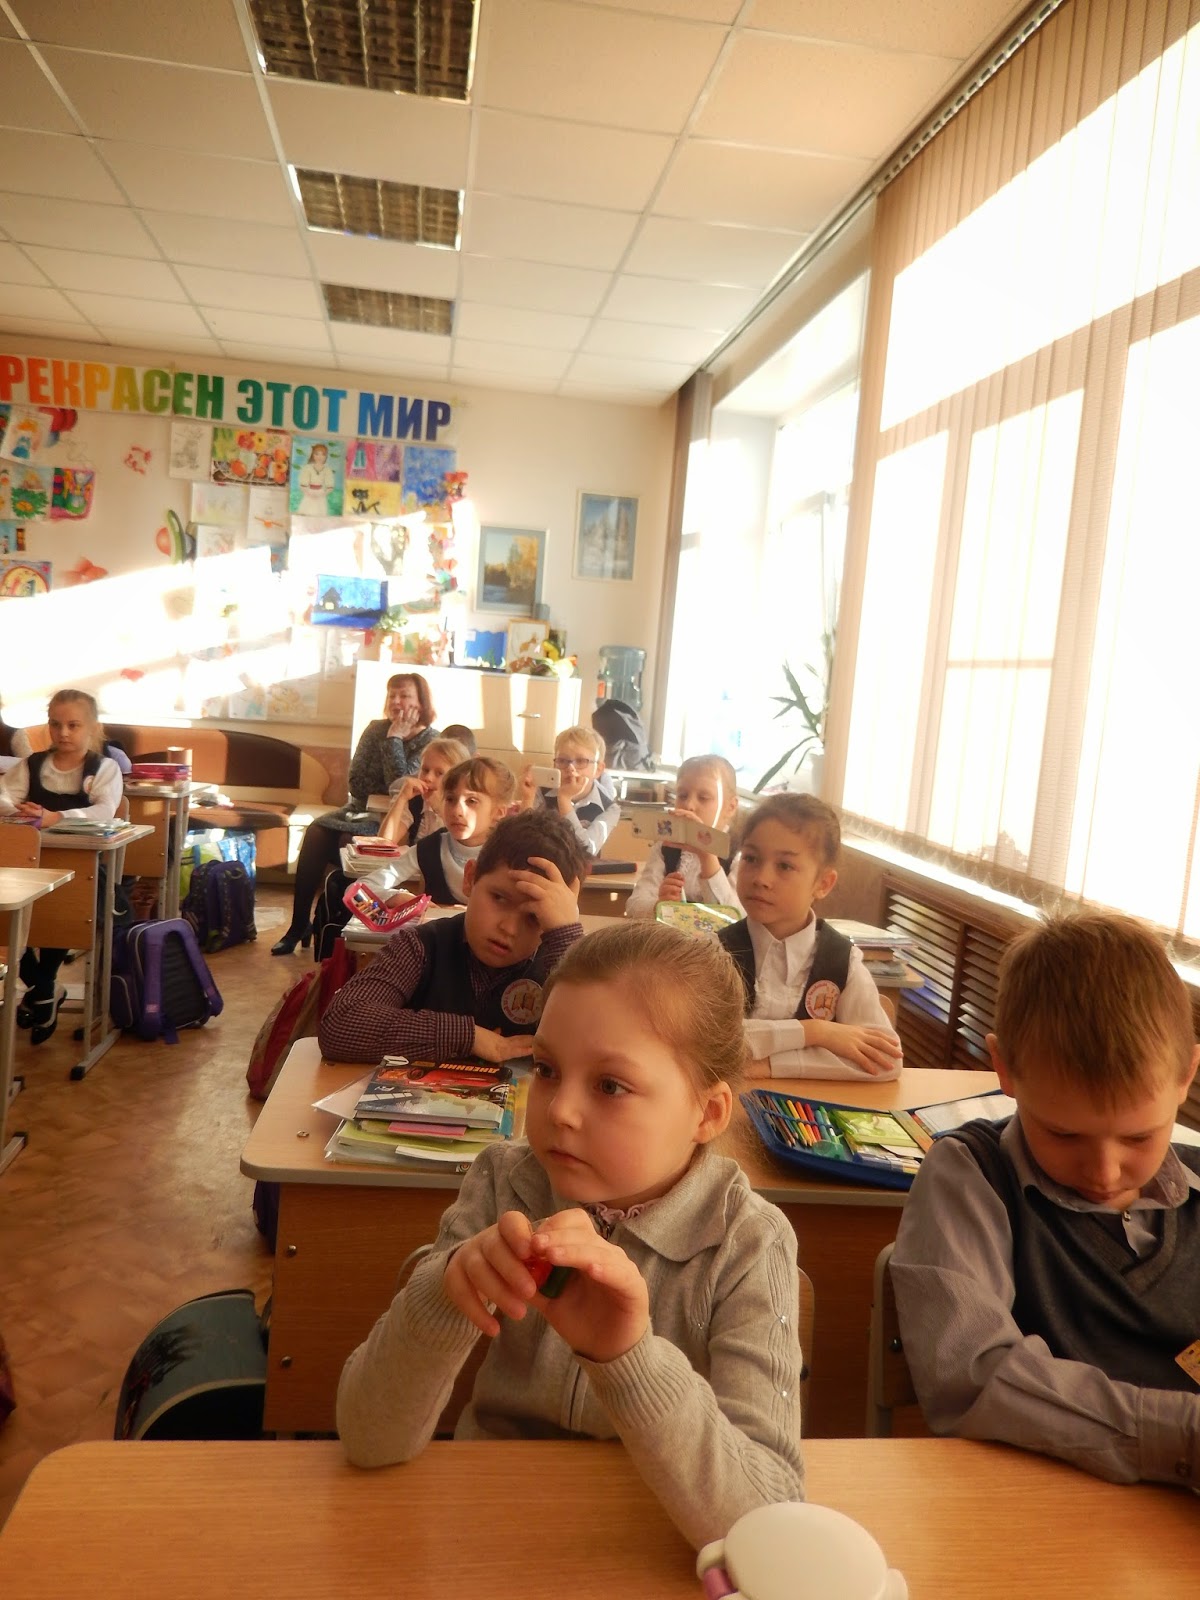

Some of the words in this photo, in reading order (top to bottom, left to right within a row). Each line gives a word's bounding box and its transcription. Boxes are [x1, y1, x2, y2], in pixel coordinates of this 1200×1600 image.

[0, 355, 225, 420] РЕКРАСЕН
[236, 379, 347, 433] ЭТОТ
[356, 392, 451, 442] МИР
[438, 1063, 500, 1074] ДНЕВНИК
